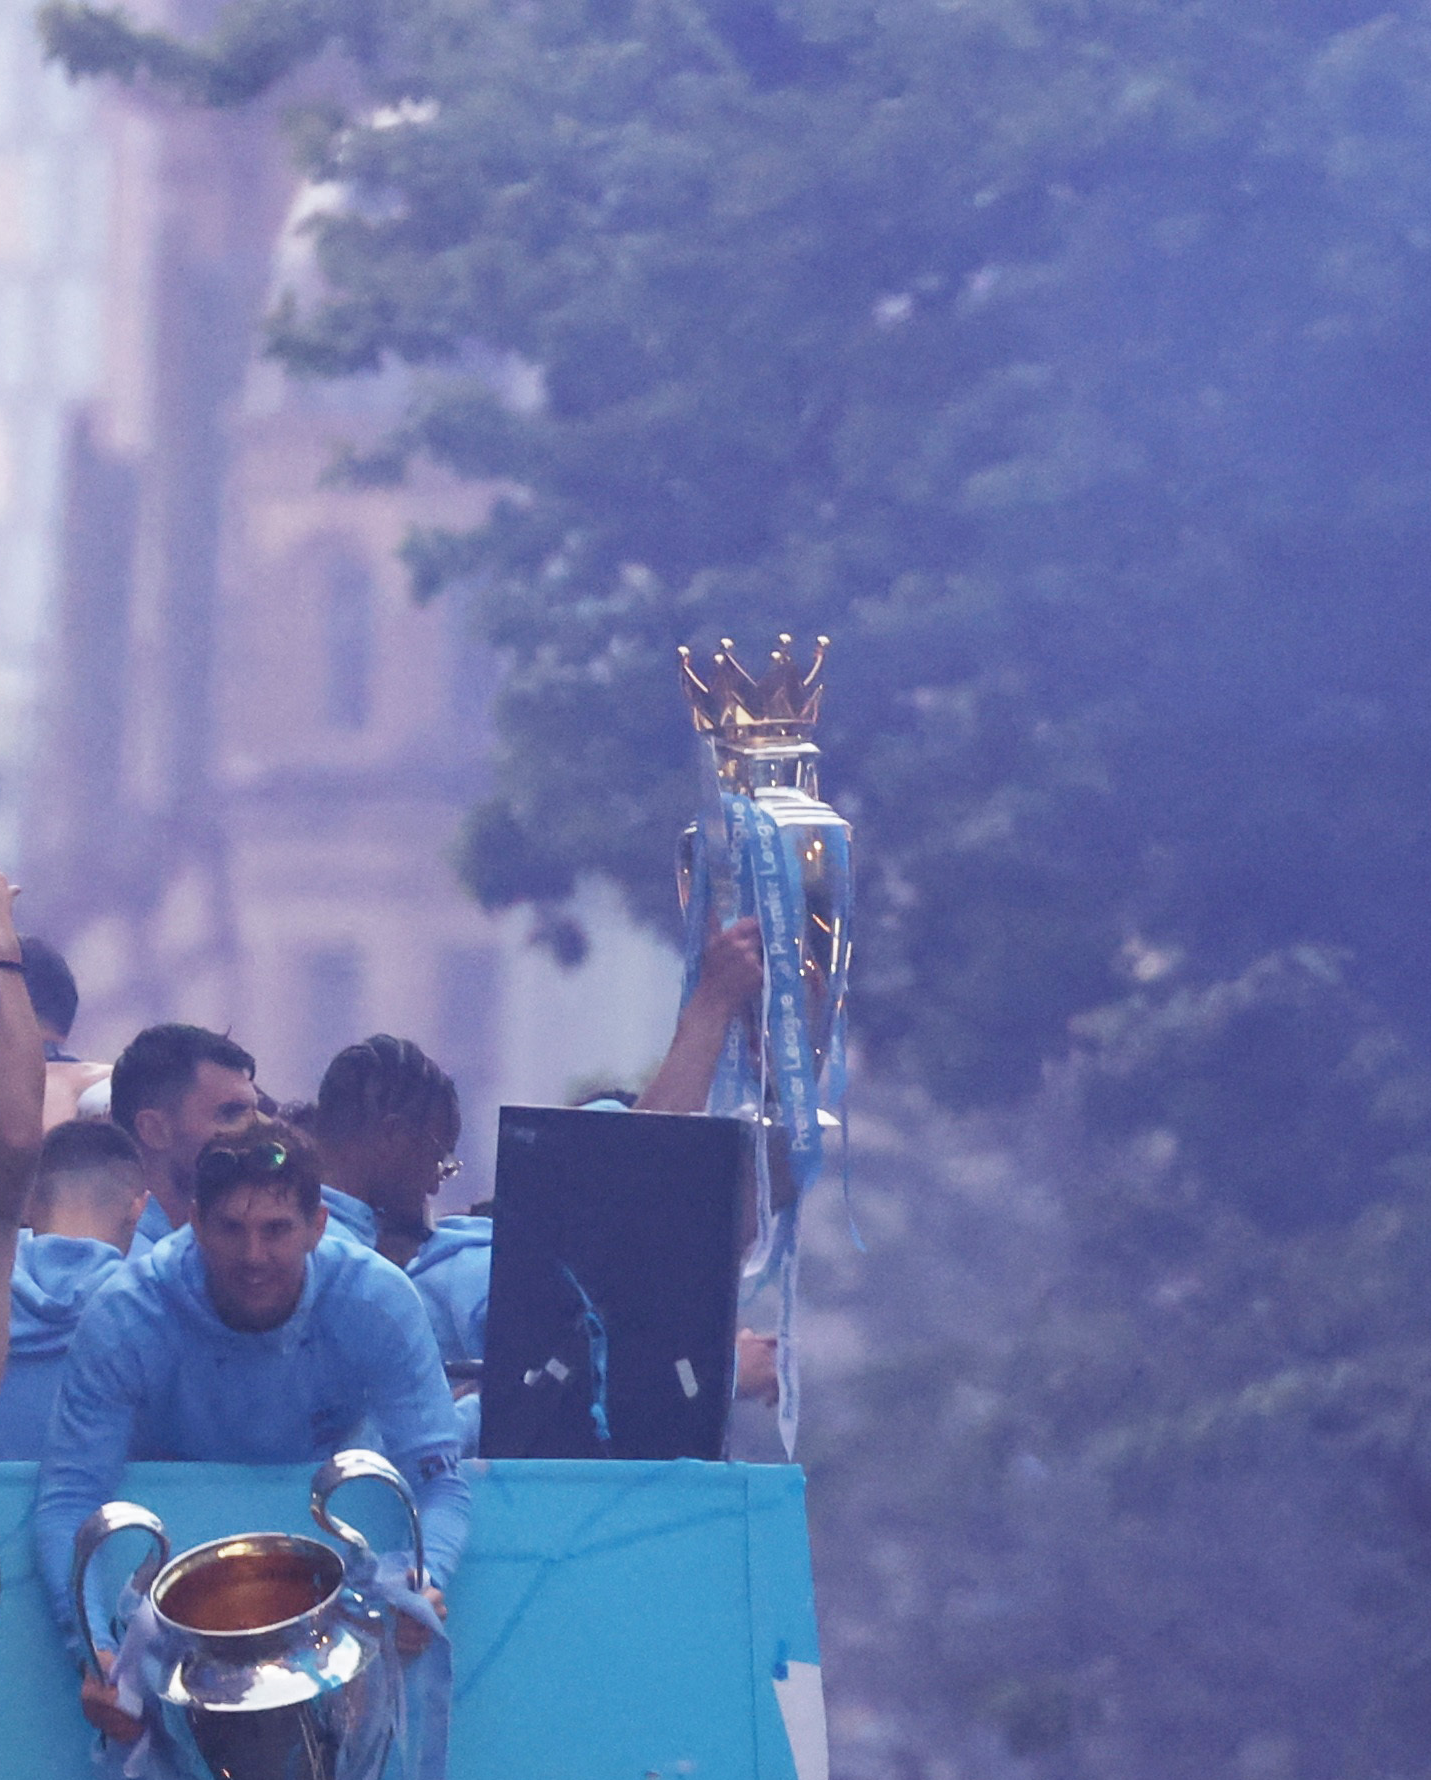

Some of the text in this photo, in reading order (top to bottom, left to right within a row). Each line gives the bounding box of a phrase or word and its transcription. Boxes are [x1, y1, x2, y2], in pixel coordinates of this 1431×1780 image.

[750, 802, 788, 955] Premier League
[780, 994, 811, 1151] Premier League
